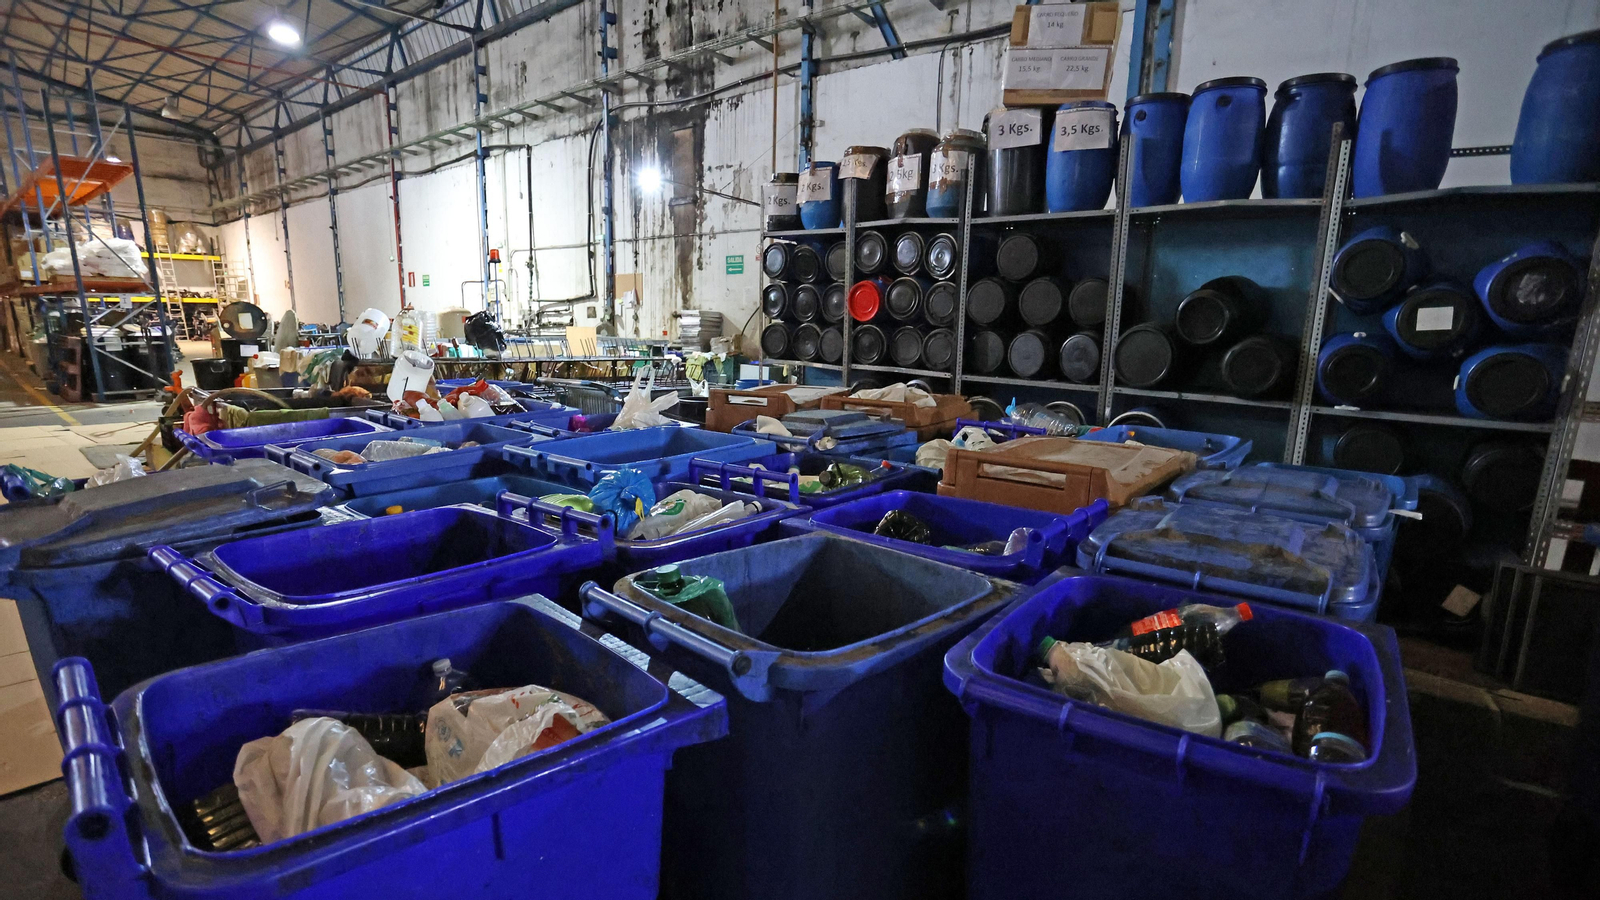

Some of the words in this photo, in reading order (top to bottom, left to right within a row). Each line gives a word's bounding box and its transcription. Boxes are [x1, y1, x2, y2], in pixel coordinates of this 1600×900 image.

[1056, 21, 1064, 29] kg
[1032, 65, 1041, 73] kg
[1081, 65, 1089, 73] kg
[998, 124, 1005, 136] 3
[1009, 123, 1033, 136] Kgs.
[1060, 126, 1077, 138] 3,5
[1081, 123, 1104, 136] Kgs.
[842, 158, 851, 167] 25
[939, 164, 959, 175] Kgs.
[801, 184, 805, 192] 2
[806, 182, 825, 192] Kgs.
[768, 196, 772, 205] 2
[772, 196, 791, 206] Kgs.
